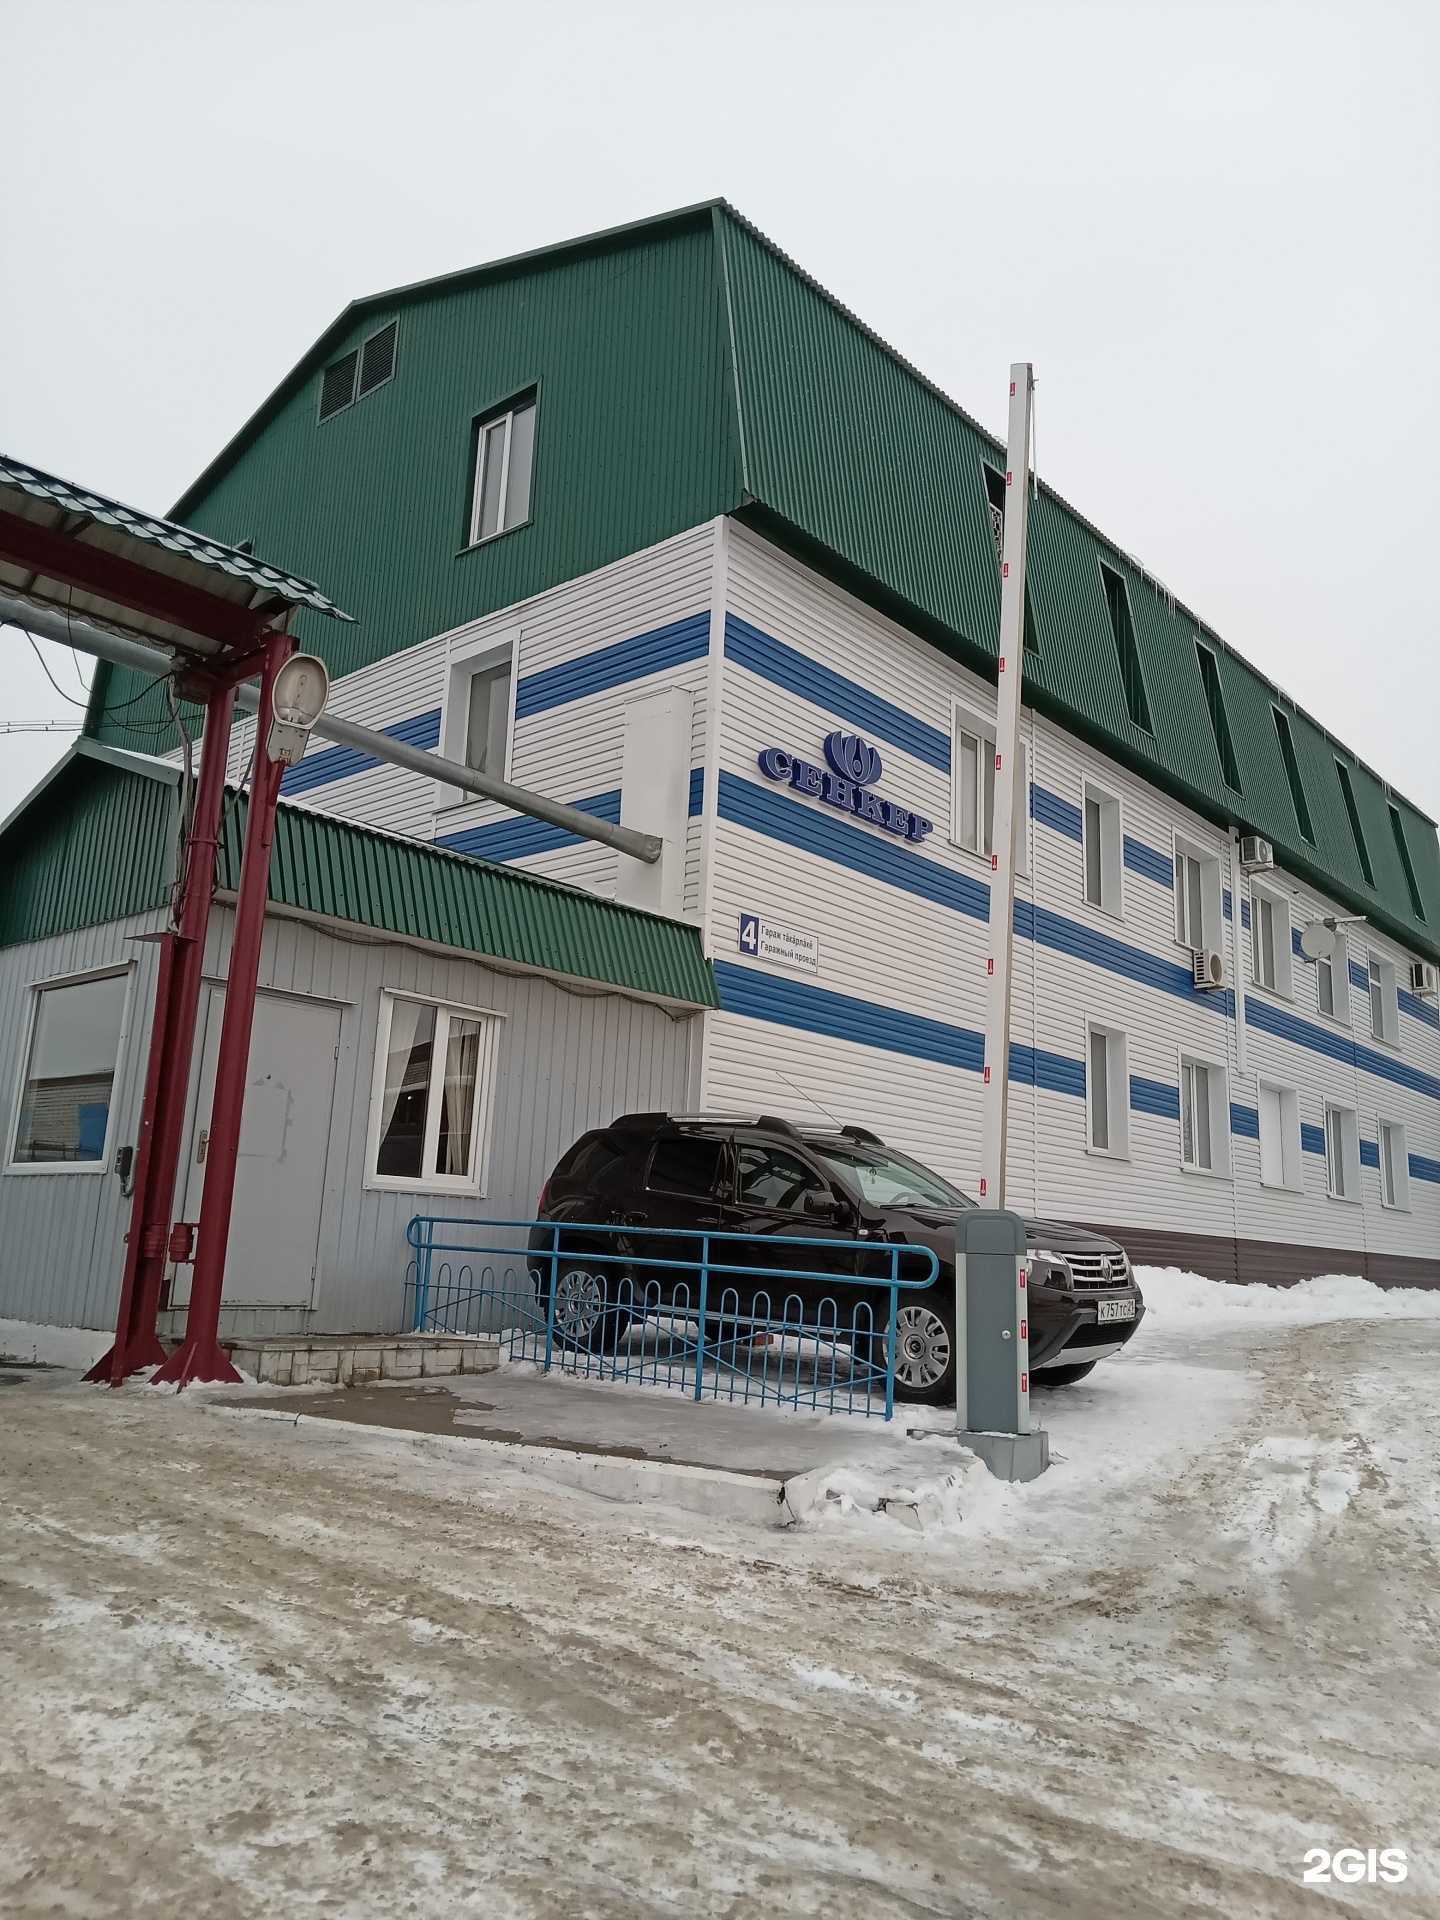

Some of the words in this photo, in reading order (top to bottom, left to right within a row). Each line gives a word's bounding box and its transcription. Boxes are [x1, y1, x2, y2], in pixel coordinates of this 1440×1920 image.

[758, 747, 934, 844] СЕНКЕР
[741, 920, 757, 950] 4
[761, 925, 781, 939] Гараж
[760, 940, 794, 958] Гаражный
[794, 953, 816, 966] проезд
